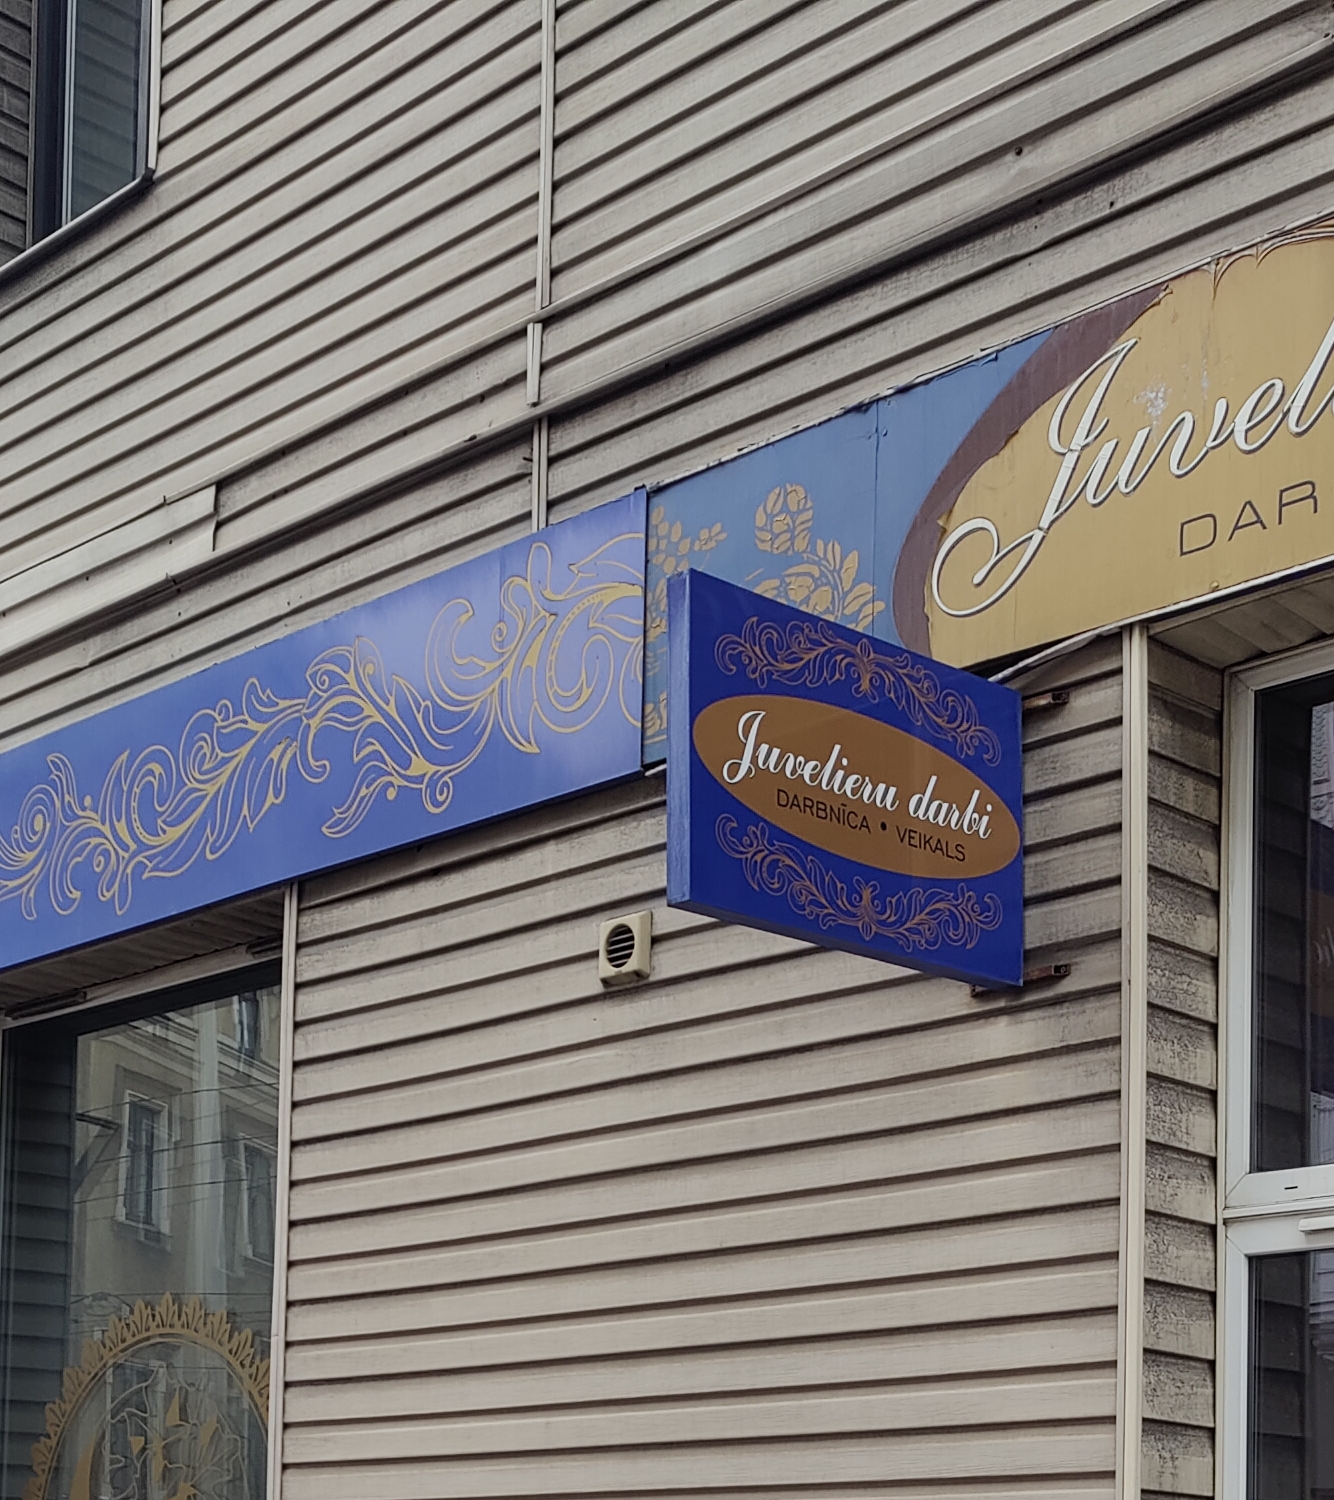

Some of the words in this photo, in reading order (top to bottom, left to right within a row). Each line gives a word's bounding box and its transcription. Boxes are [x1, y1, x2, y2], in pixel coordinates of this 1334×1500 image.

[722, 710, 899, 811] Juvelieru
[908, 775, 993, 839] darbi
[776, 788, 871, 834] DARBNĪCA
[896, 825, 966, 862] VEIKALS
